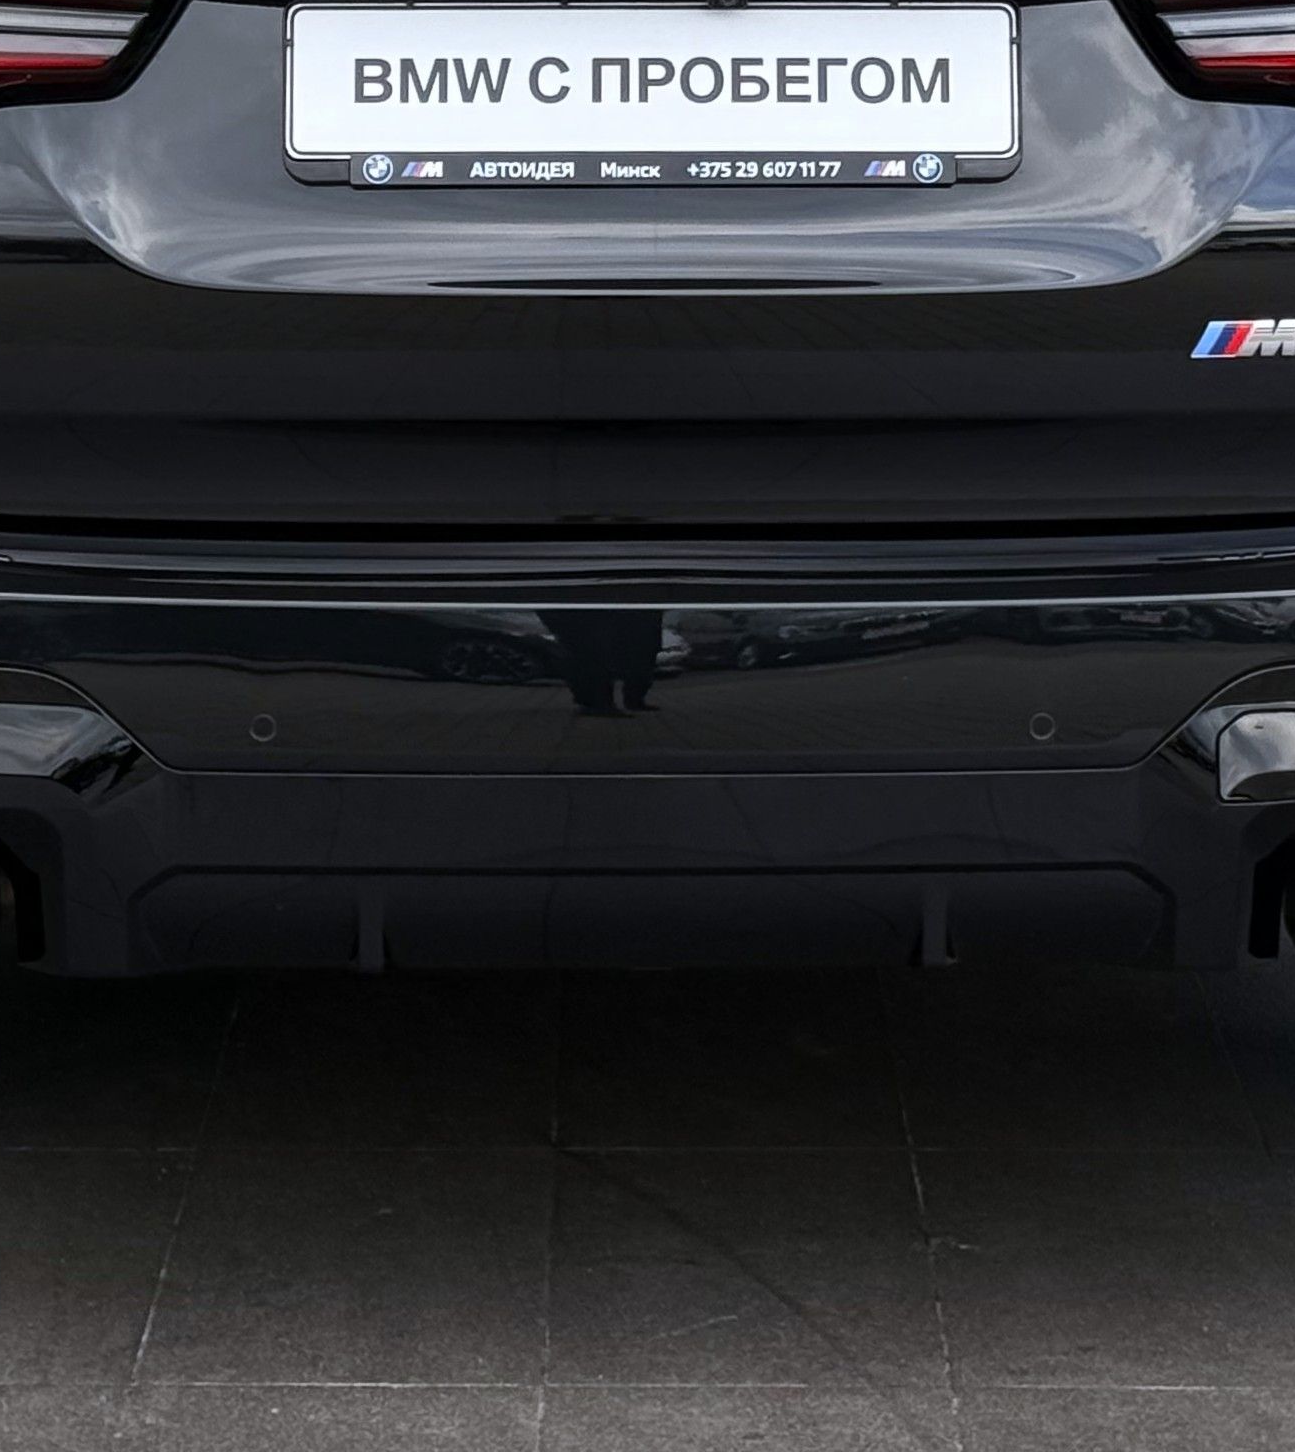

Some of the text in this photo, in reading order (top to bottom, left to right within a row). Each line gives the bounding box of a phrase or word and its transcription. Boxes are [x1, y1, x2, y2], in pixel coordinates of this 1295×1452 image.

[354, 56, 950, 104] BMW С ПРОБЕГОМ
[469, 161, 575, 180] АВТОИДЕЯ
[600, 162, 661, 178] Минск
[686, 161, 732, 178] +375
[735, 161, 759, 178] 29
